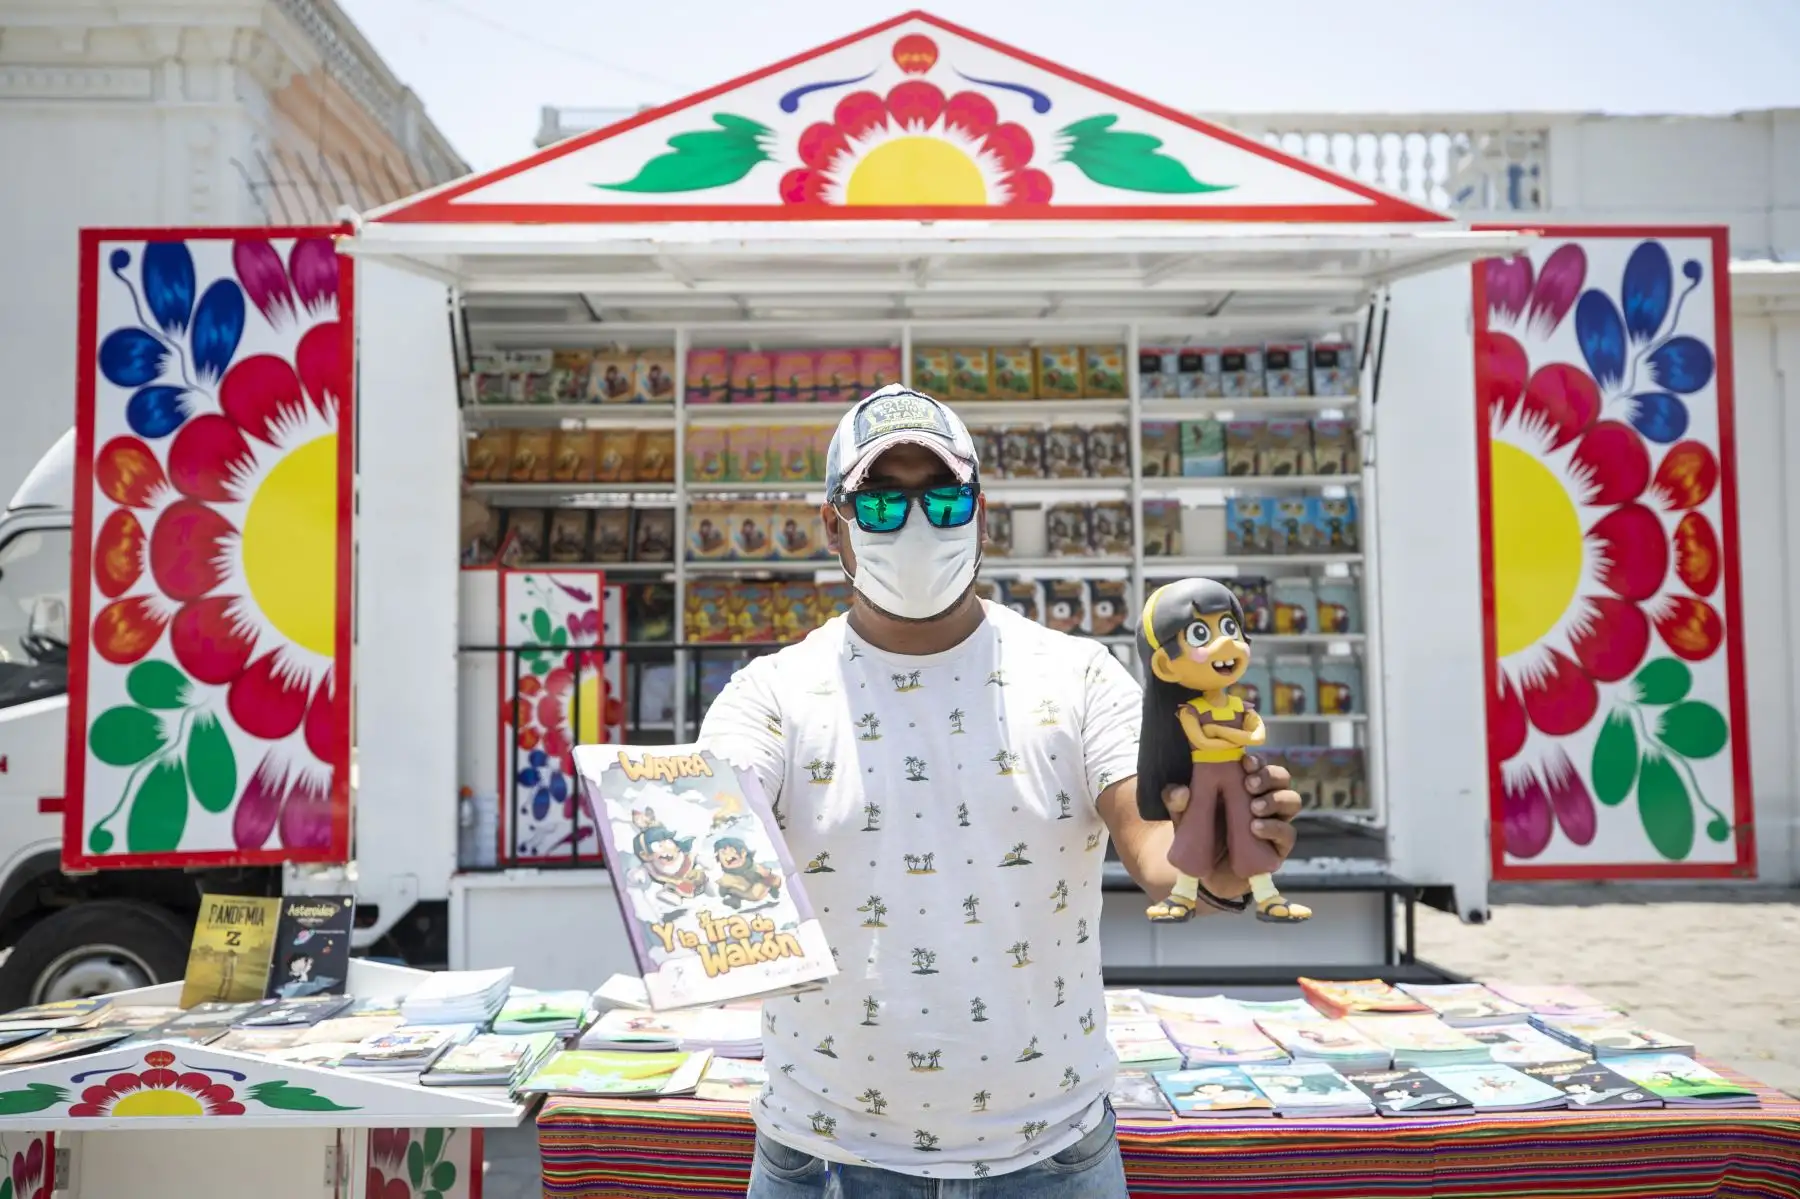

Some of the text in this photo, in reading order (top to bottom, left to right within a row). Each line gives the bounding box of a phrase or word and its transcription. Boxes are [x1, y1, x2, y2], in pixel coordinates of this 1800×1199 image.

[617, 751, 714, 784] WAYRA
[208, 903, 265, 927] PANDEMIA
[225, 931, 242, 946] Z
[651, 922, 676, 953] Y
[677, 927, 700, 949] la
[750, 912, 776, 933] de
